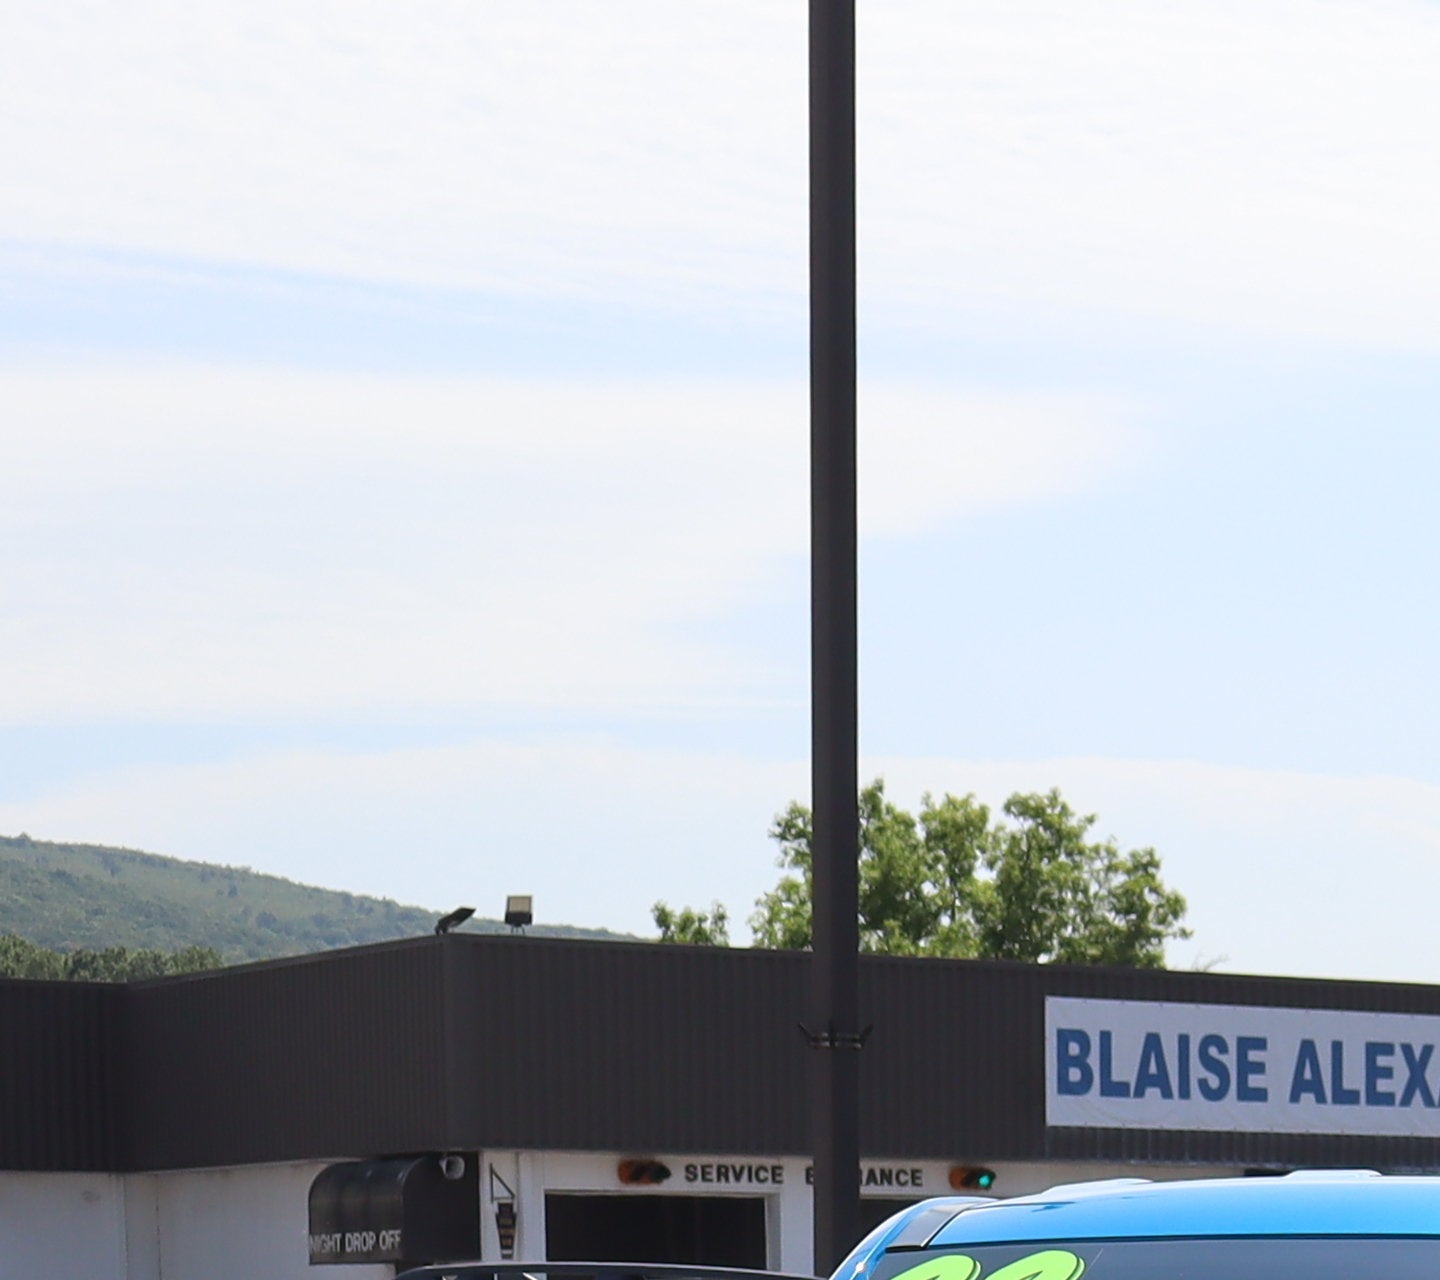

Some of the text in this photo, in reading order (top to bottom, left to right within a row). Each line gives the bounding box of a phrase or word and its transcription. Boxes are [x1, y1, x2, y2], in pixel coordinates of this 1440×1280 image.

[1055, 1027, 1269, 1103] BLAISE
[684, 1163, 923, 1187] SERVICE EANCE
[309, 1228, 402, 1254] NIGHT DROP OFF
